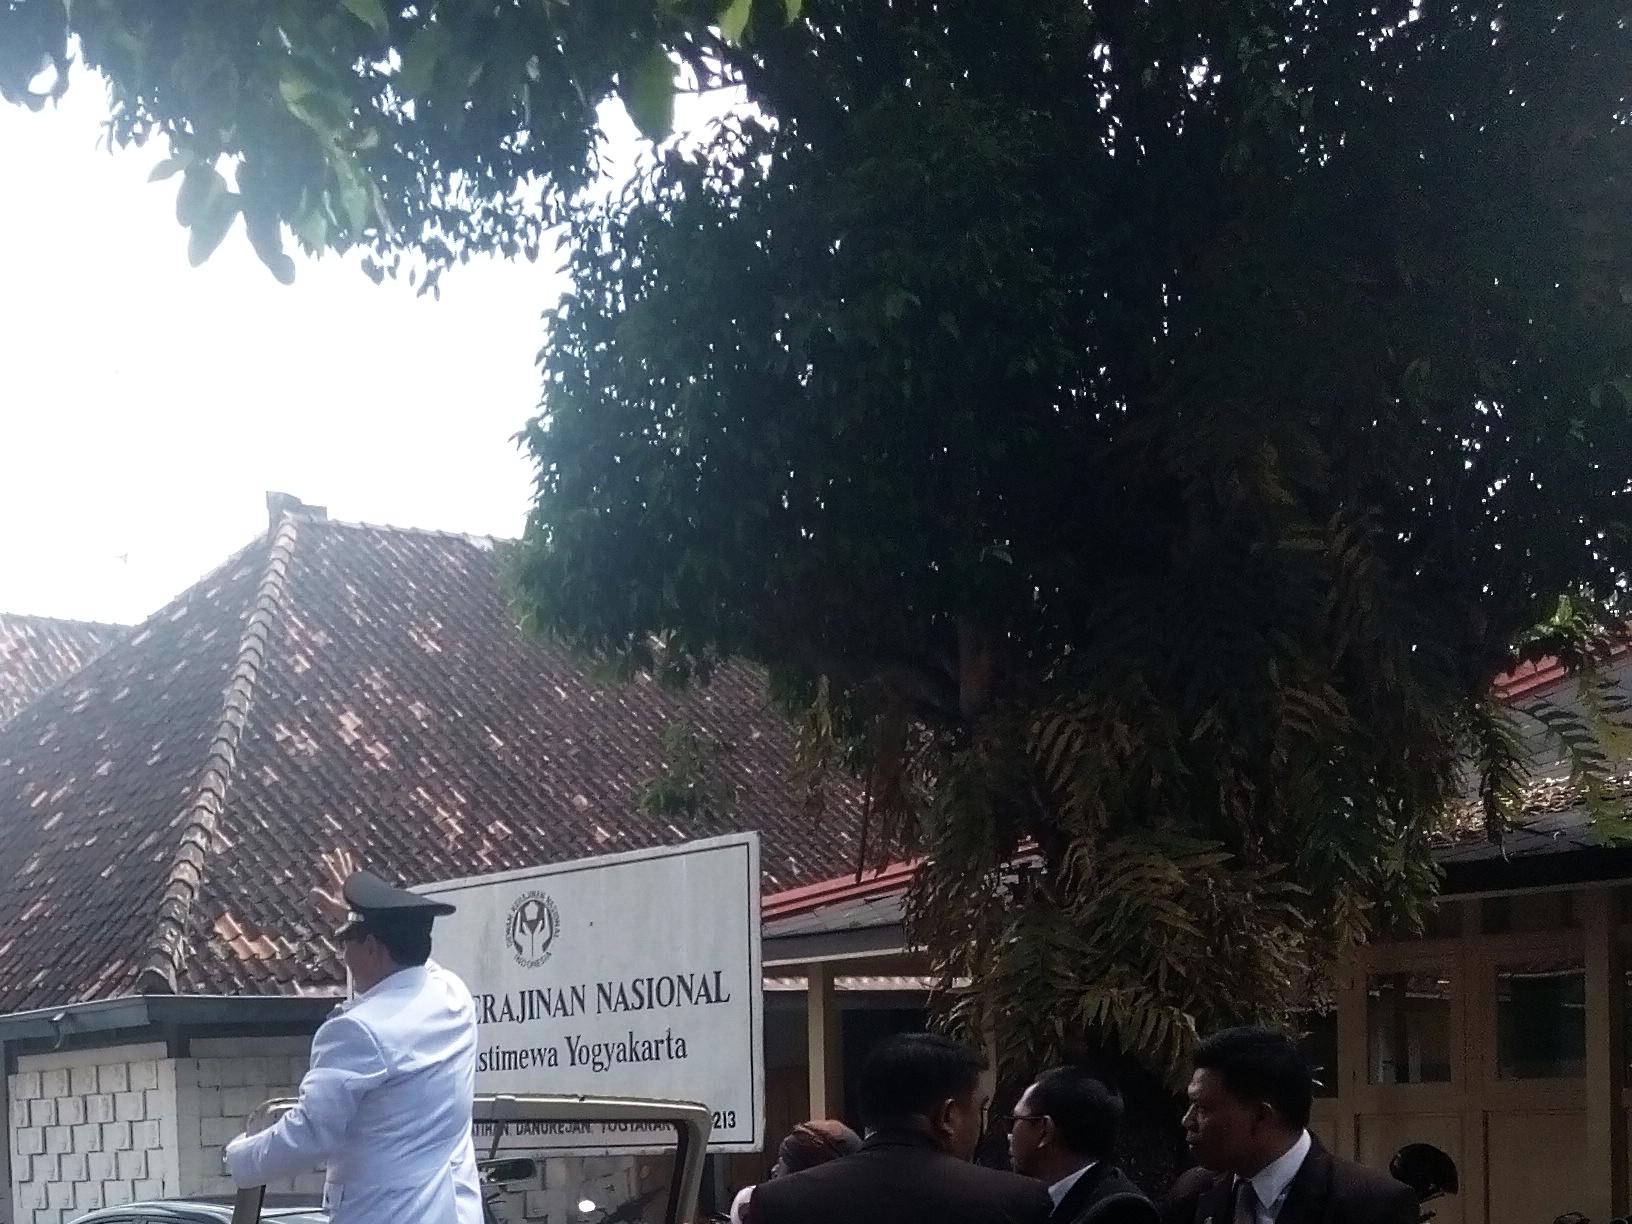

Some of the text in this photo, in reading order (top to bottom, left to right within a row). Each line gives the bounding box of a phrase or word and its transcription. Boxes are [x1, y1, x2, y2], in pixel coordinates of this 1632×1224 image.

[596, 971, 731, 1014] NASIONAL
[475, 1027, 688, 1073] stimewa Yogyakarta
